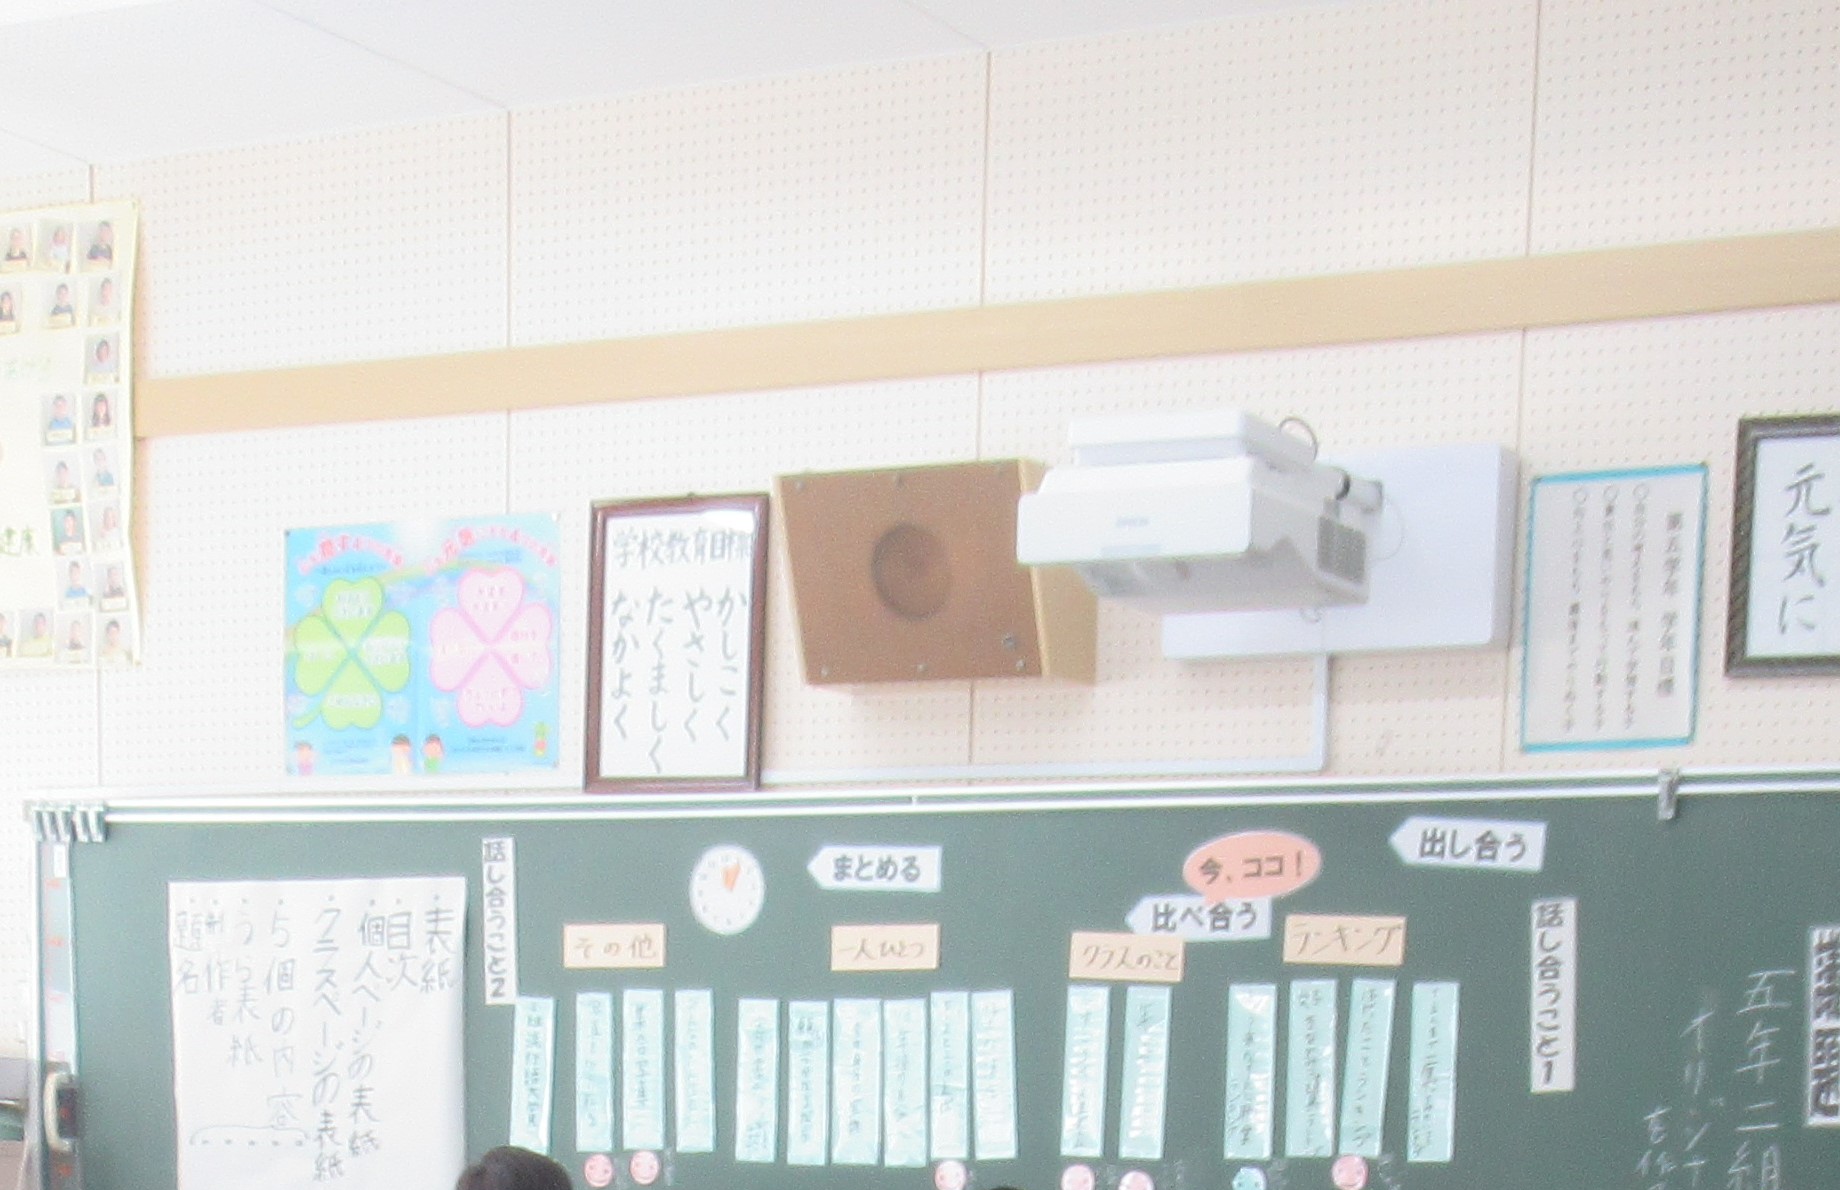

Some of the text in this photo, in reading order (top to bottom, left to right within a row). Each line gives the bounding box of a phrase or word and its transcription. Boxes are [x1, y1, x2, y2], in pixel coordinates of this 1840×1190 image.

[1779, 462, 1831, 635] 元気に
[611, 589, 642, 741] なかよく
[646, 586, 674, 775] たくましく
[683, 588, 713, 743] やさしく
[715, 587, 748, 742] かしこく
[832, 855, 922, 883] まとめる
[1419, 826, 1530, 864] 出し合う
[172, 909, 204, 995] 題名
[384, 911, 418, 991] 目次
[420, 907, 456, 994] 表紙
[573, 931, 657, 961] その他
[1151, 902, 1259, 934] 比べ合う
[1294, 921, 1402, 957] ランキング
